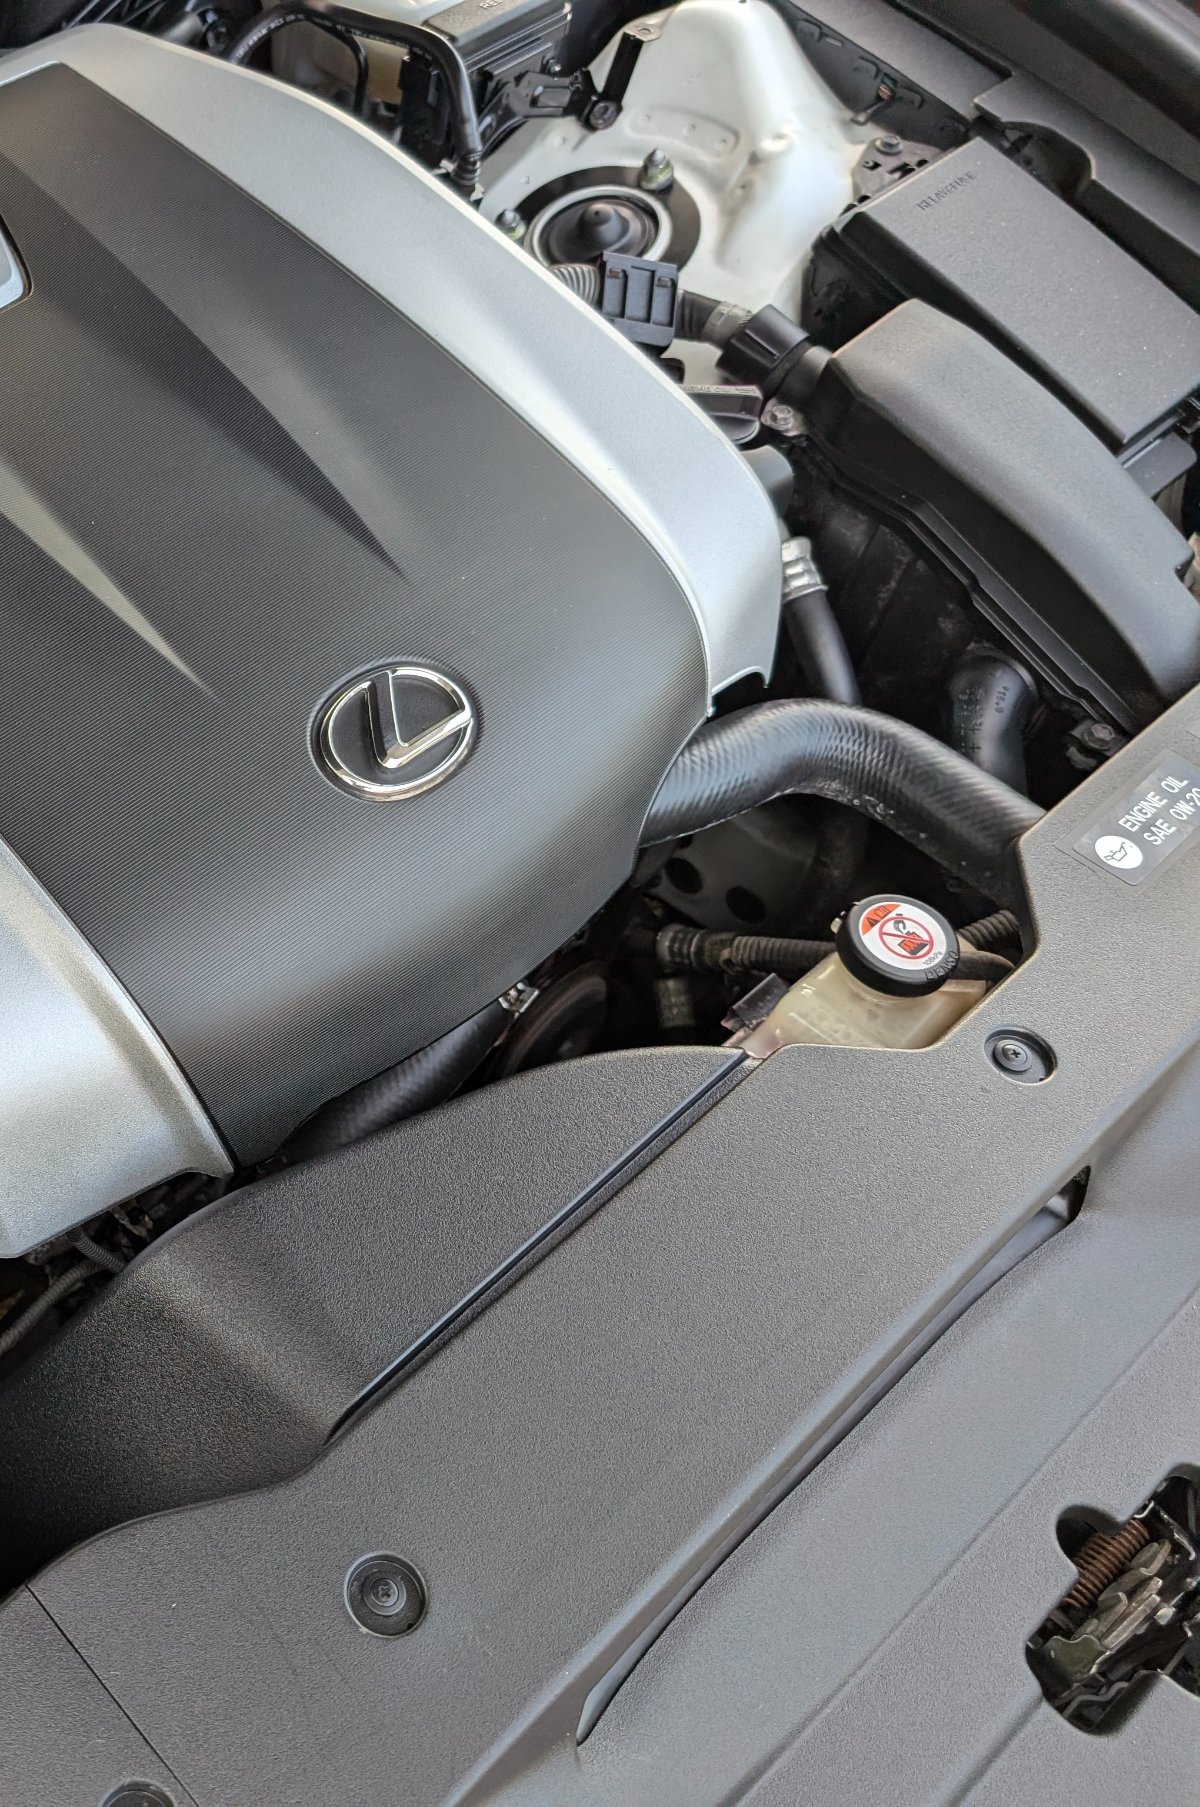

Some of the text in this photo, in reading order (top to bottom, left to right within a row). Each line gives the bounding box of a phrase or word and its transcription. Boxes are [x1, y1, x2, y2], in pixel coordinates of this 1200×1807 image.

[1118, 776, 1188, 832] ENGINE OIL
[1144, 819, 1176, 845] SAE
[925, 950, 959, 980] DENSO
